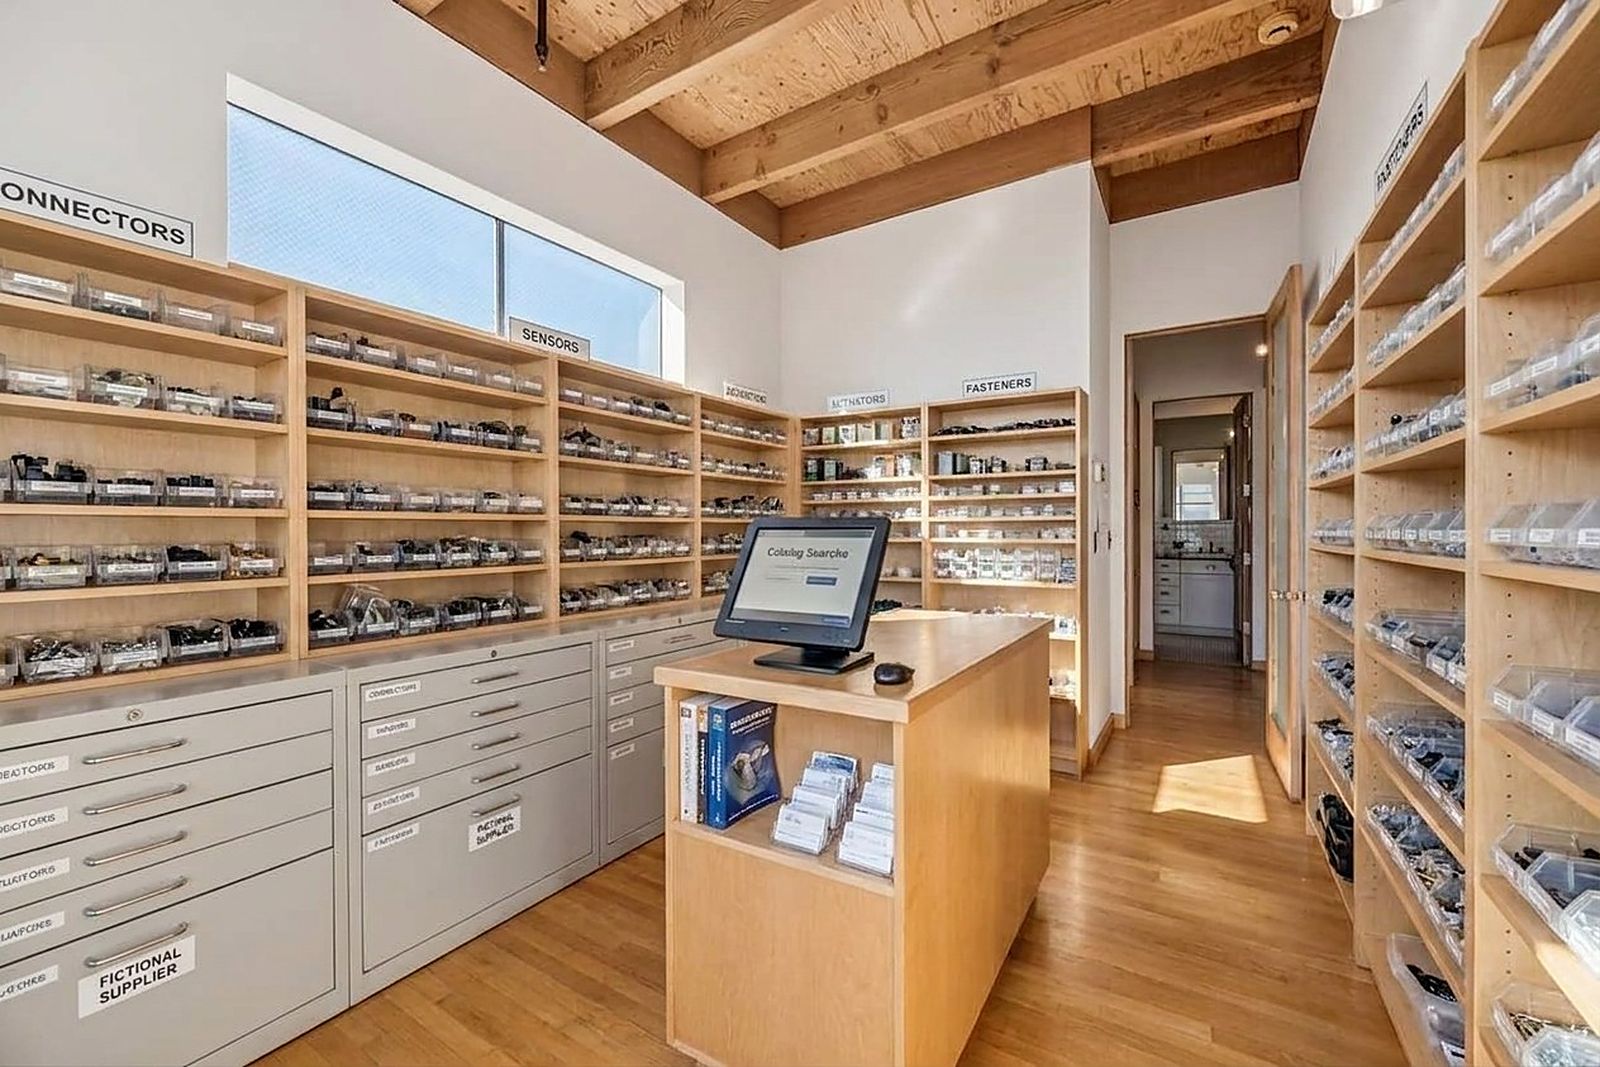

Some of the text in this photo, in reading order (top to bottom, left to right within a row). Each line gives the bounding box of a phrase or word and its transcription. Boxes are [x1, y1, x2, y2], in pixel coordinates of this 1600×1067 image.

[0, 182, 185, 245] ONNECTORS
[522, 328, 579, 353] SENSORS
[966, 378, 1032, 393] FASTENERS
[99, 947, 182, 988] FICTIONAL
[99, 962, 178, 1004] SUPPLIER
